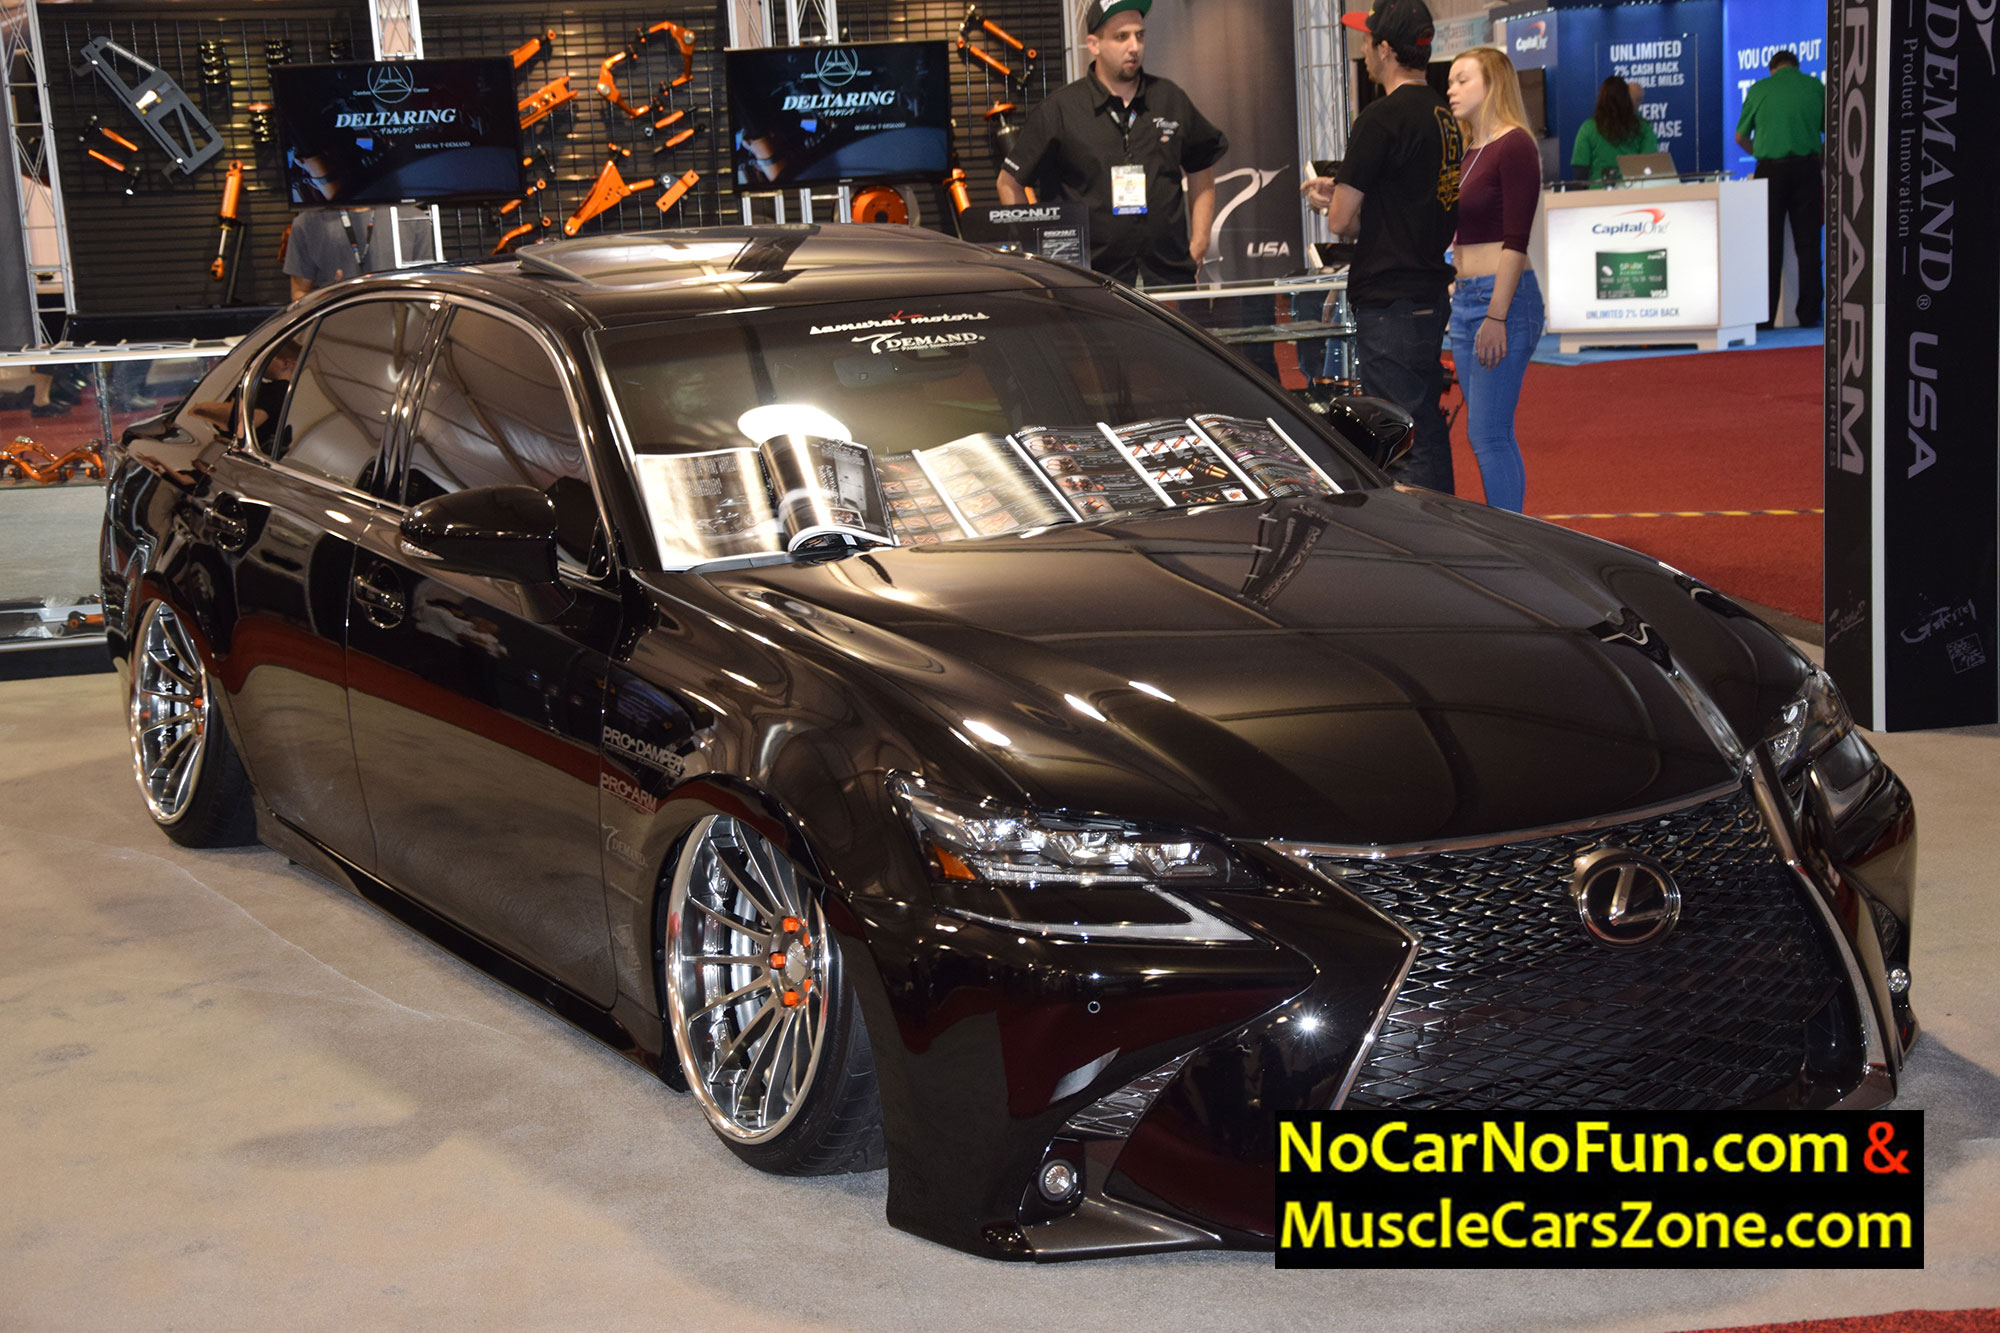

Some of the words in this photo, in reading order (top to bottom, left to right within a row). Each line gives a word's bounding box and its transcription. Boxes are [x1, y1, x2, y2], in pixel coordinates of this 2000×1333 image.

[1610, 40, 1682, 62] UNLIMITED
[1737, 48, 1759, 70] YOU
[1799, 38, 1822, 62] PUT
[1630, 62, 1654, 76] CASH
[1655, 61, 1680, 75] BACK
[1901, 38, 1918, 119] Product
[1658, 73, 1685, 87] MILES
[782, 90, 896, 111] DELTARING
[335, 108, 456, 128] DELTARING
[1898, 128, 1916, 237] Innovation
[1246, 241, 1291, 258] USA
[910, 311, 990, 325] motors
[1586, 309, 1624, 320] UNLIMITED
[1639, 307, 1659, 318] CASH
[1660, 306, 1680, 317] BACK
[1908, 331, 1939, 479] USA
